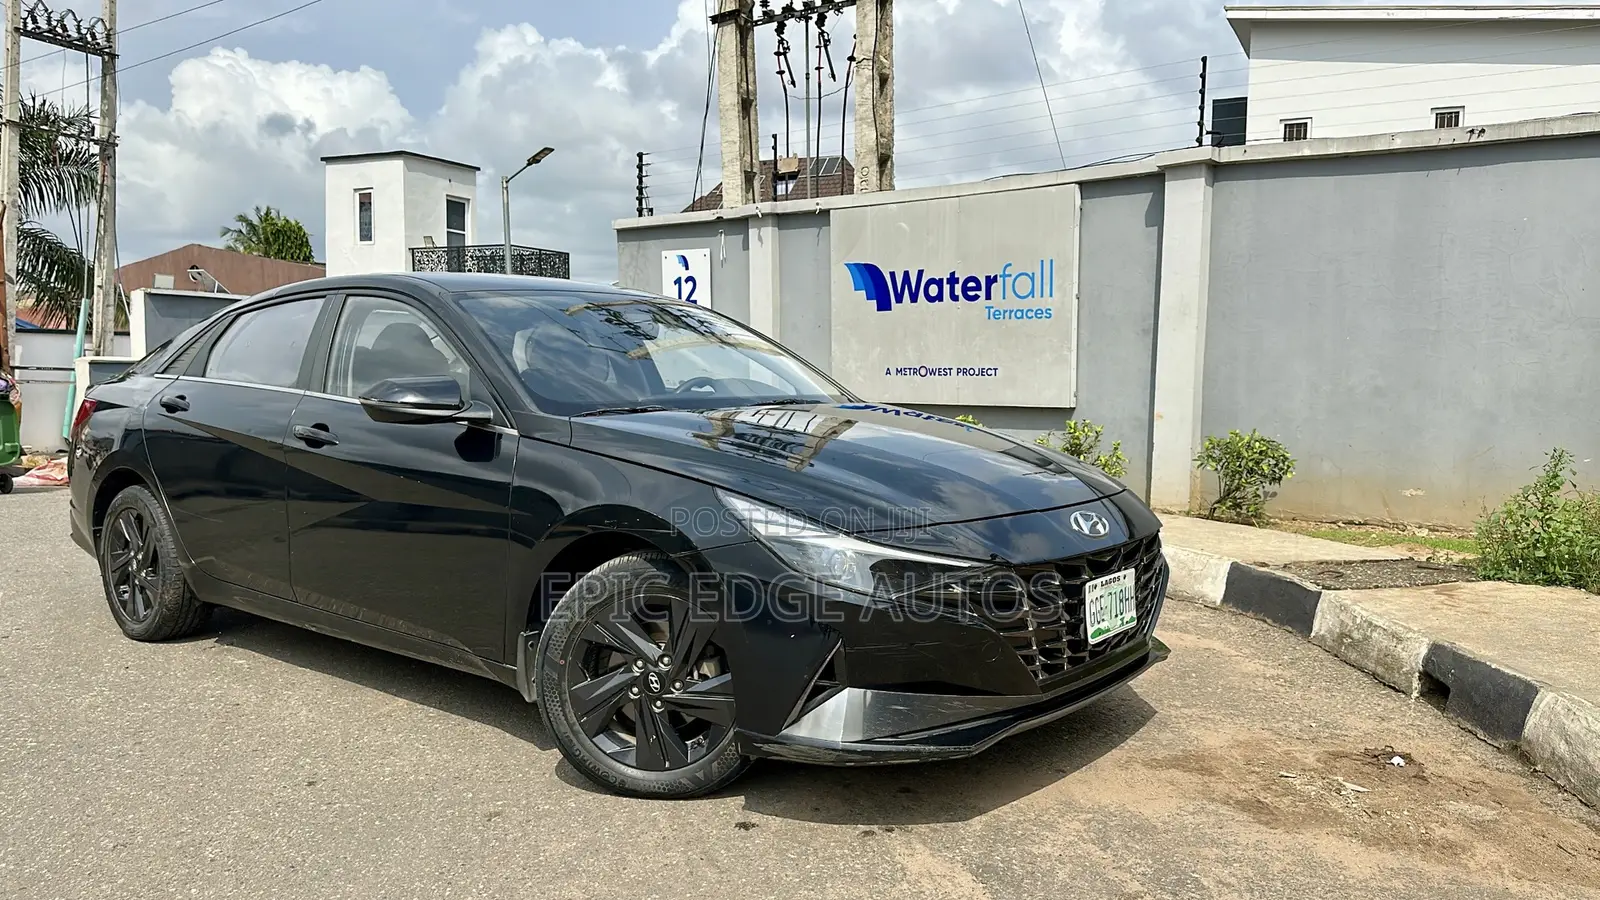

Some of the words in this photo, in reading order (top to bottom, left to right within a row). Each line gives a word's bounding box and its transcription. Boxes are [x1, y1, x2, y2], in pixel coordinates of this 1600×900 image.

[889, 259, 1054, 304] Waterfall
[673, 275, 698, 304] 12
[985, 305, 1052, 320] Terraces
[885, 367, 892, 377] A
[895, 365, 953, 378] METROWEST
[956, 367, 999, 377] PROJECT
[1100, 575, 1121, 587] LAGOS
